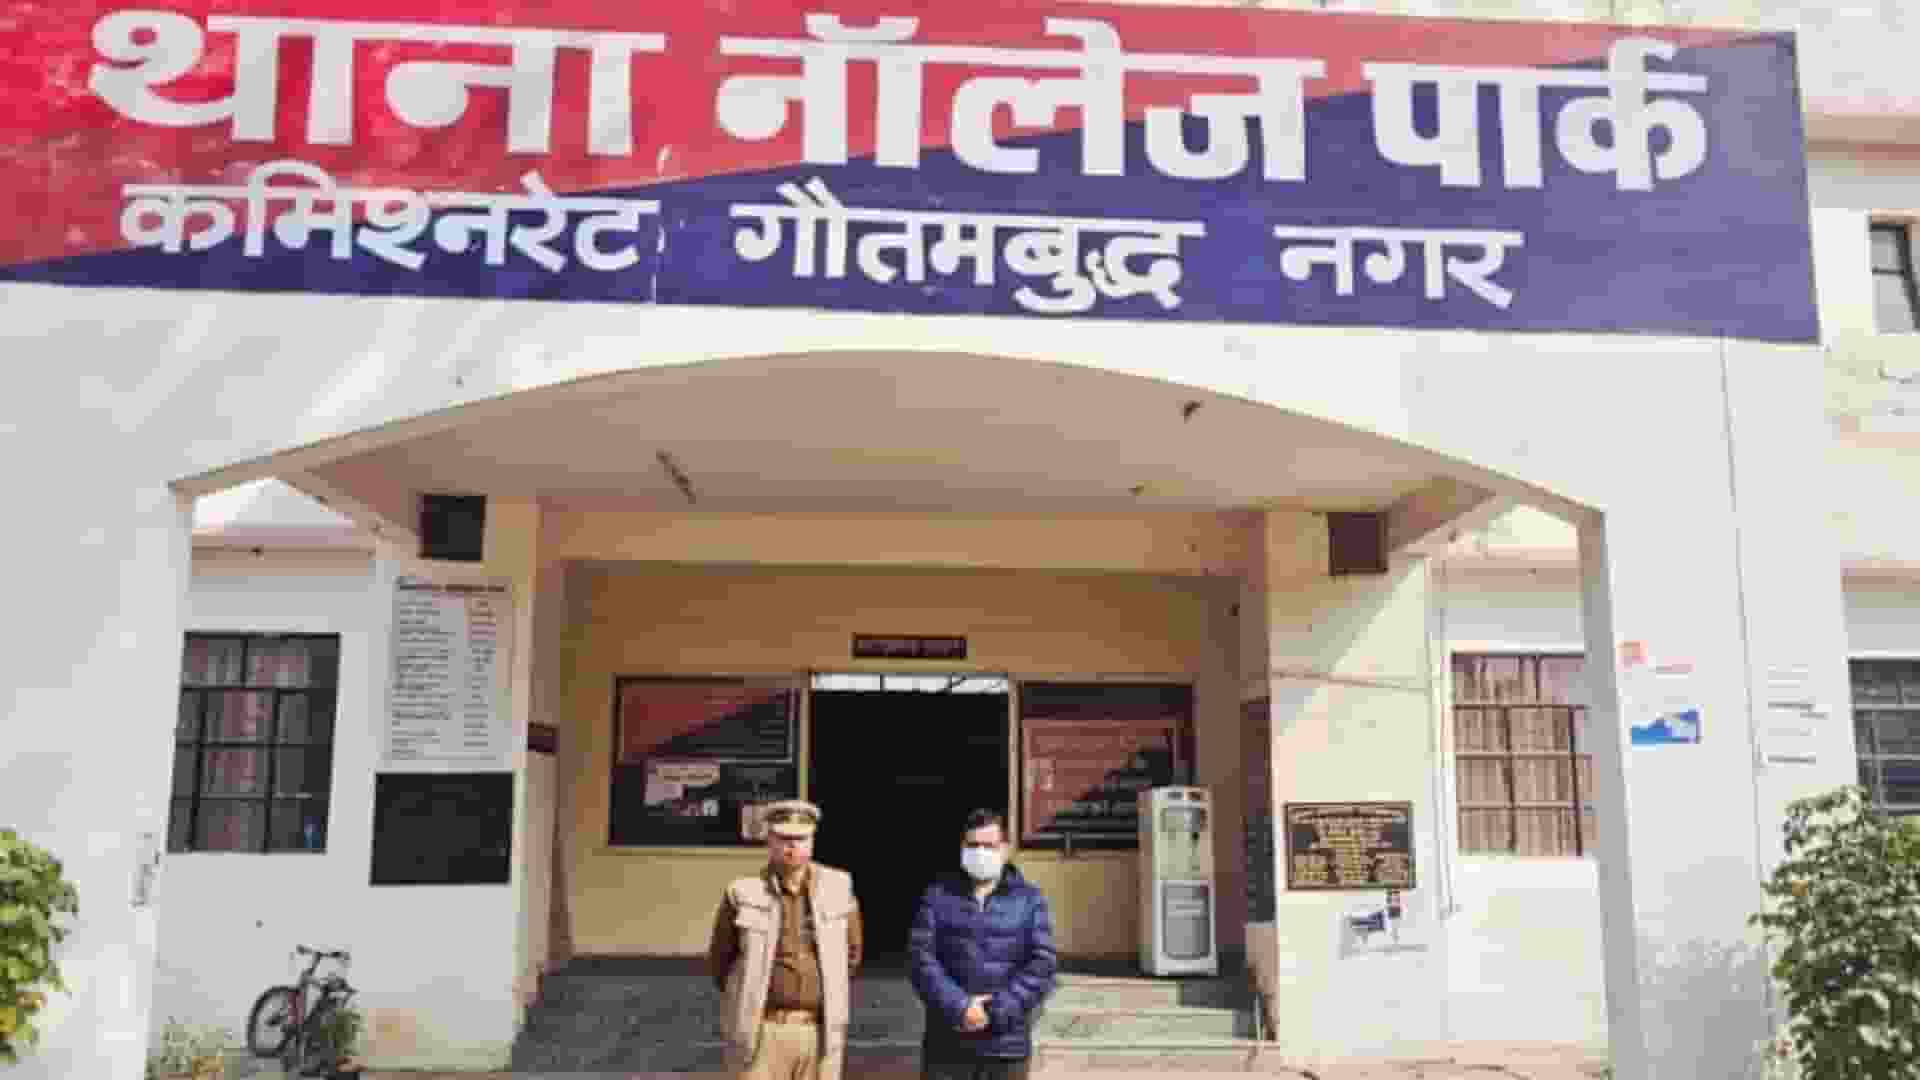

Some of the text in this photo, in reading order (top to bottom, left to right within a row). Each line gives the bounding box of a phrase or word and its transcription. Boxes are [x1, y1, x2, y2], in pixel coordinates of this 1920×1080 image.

[89, 9, 1708, 191] थाना नॉलेज पार्क
[119, 160, 1524, 313] कमिश्नरेट गौतमबुद्ध नगर
